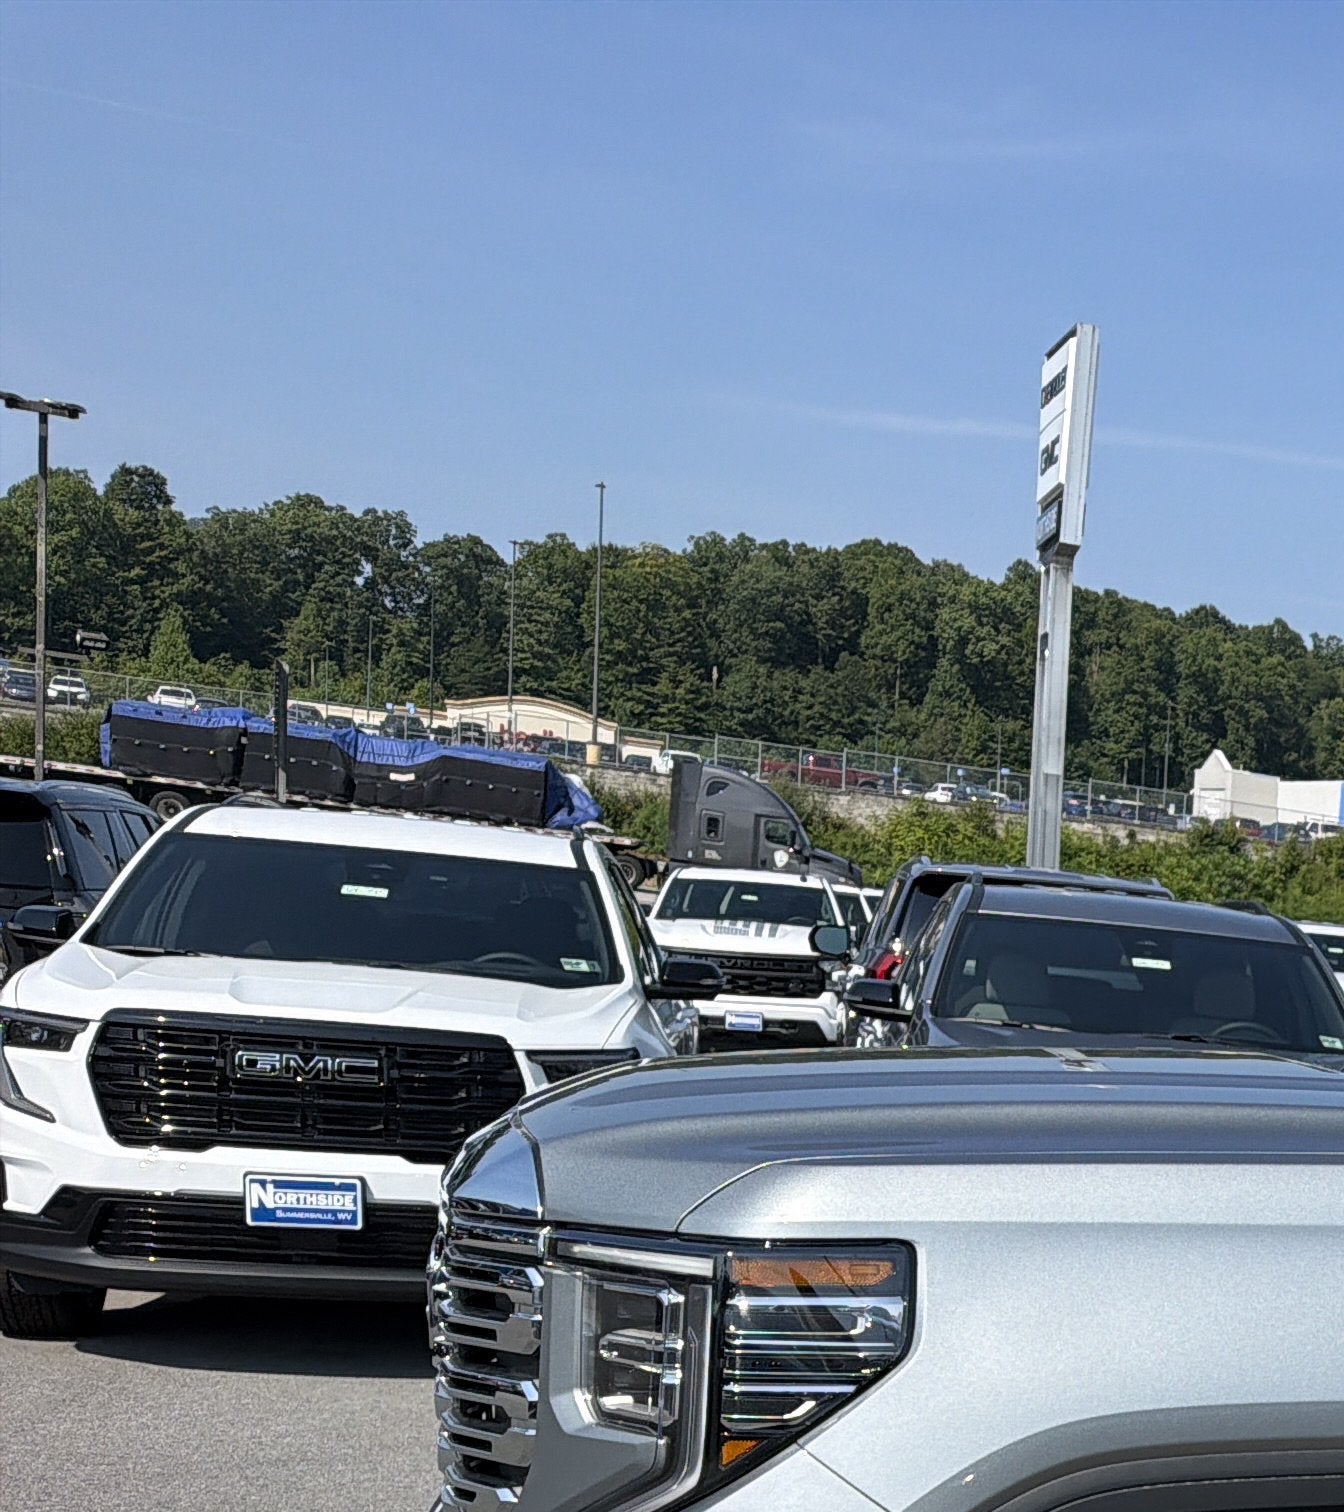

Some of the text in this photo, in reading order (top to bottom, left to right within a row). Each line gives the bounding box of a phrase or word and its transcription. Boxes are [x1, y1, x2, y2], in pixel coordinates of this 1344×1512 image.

[235, 1051, 379, 1083] GMC
[250, 1182, 355, 1209] NORTHSIDE
[336, 1211, 353, 1220] WV
